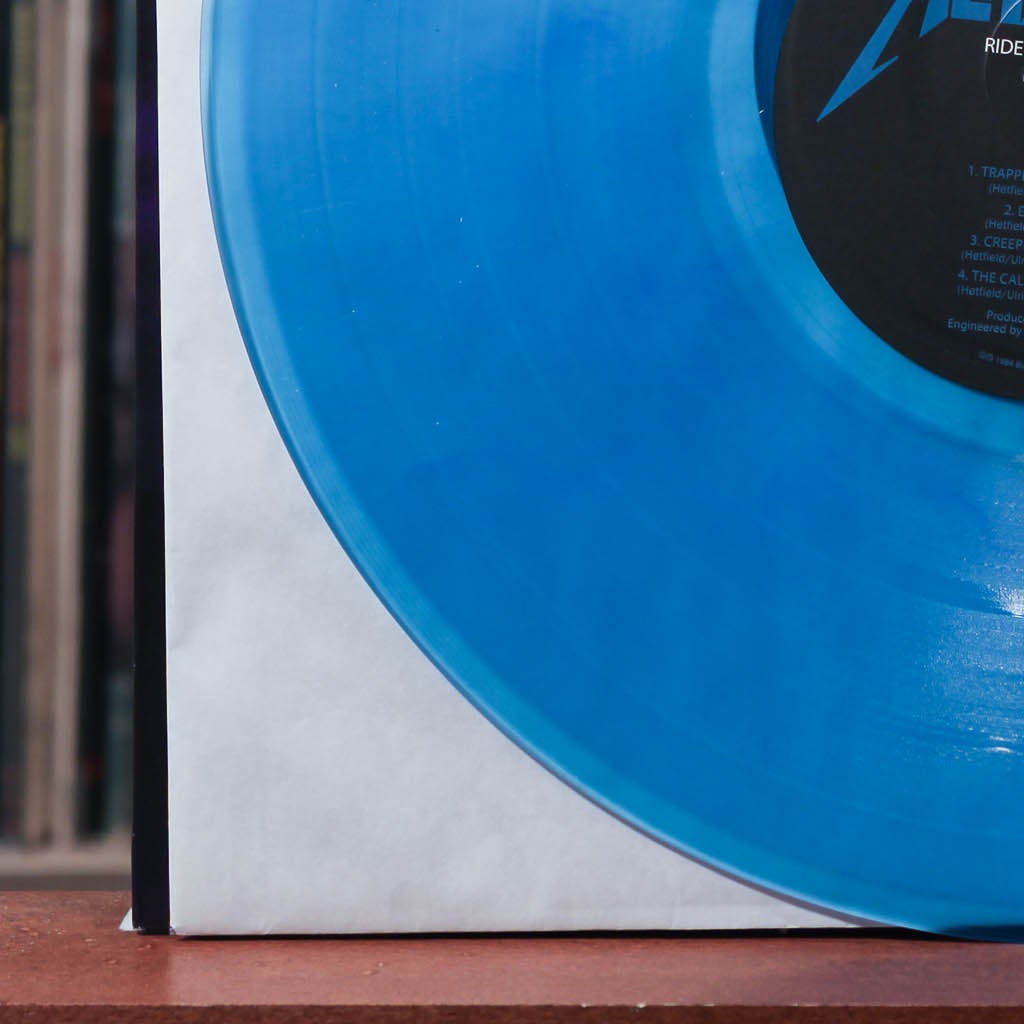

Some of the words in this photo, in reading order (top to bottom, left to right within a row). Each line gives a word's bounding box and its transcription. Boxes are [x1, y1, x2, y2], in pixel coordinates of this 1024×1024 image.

[984, 37, 1024, 56] RIDE
[968, 165, 979, 177] 1.
[1004, 204, 1014, 216] 2.
[969, 235, 980, 247] 3.
[957, 269, 968, 281] 4.
[971, 270, 996, 284] THE
[947, 318, 1006, 334] Engineered
[1009, 324, 1023, 337] by
